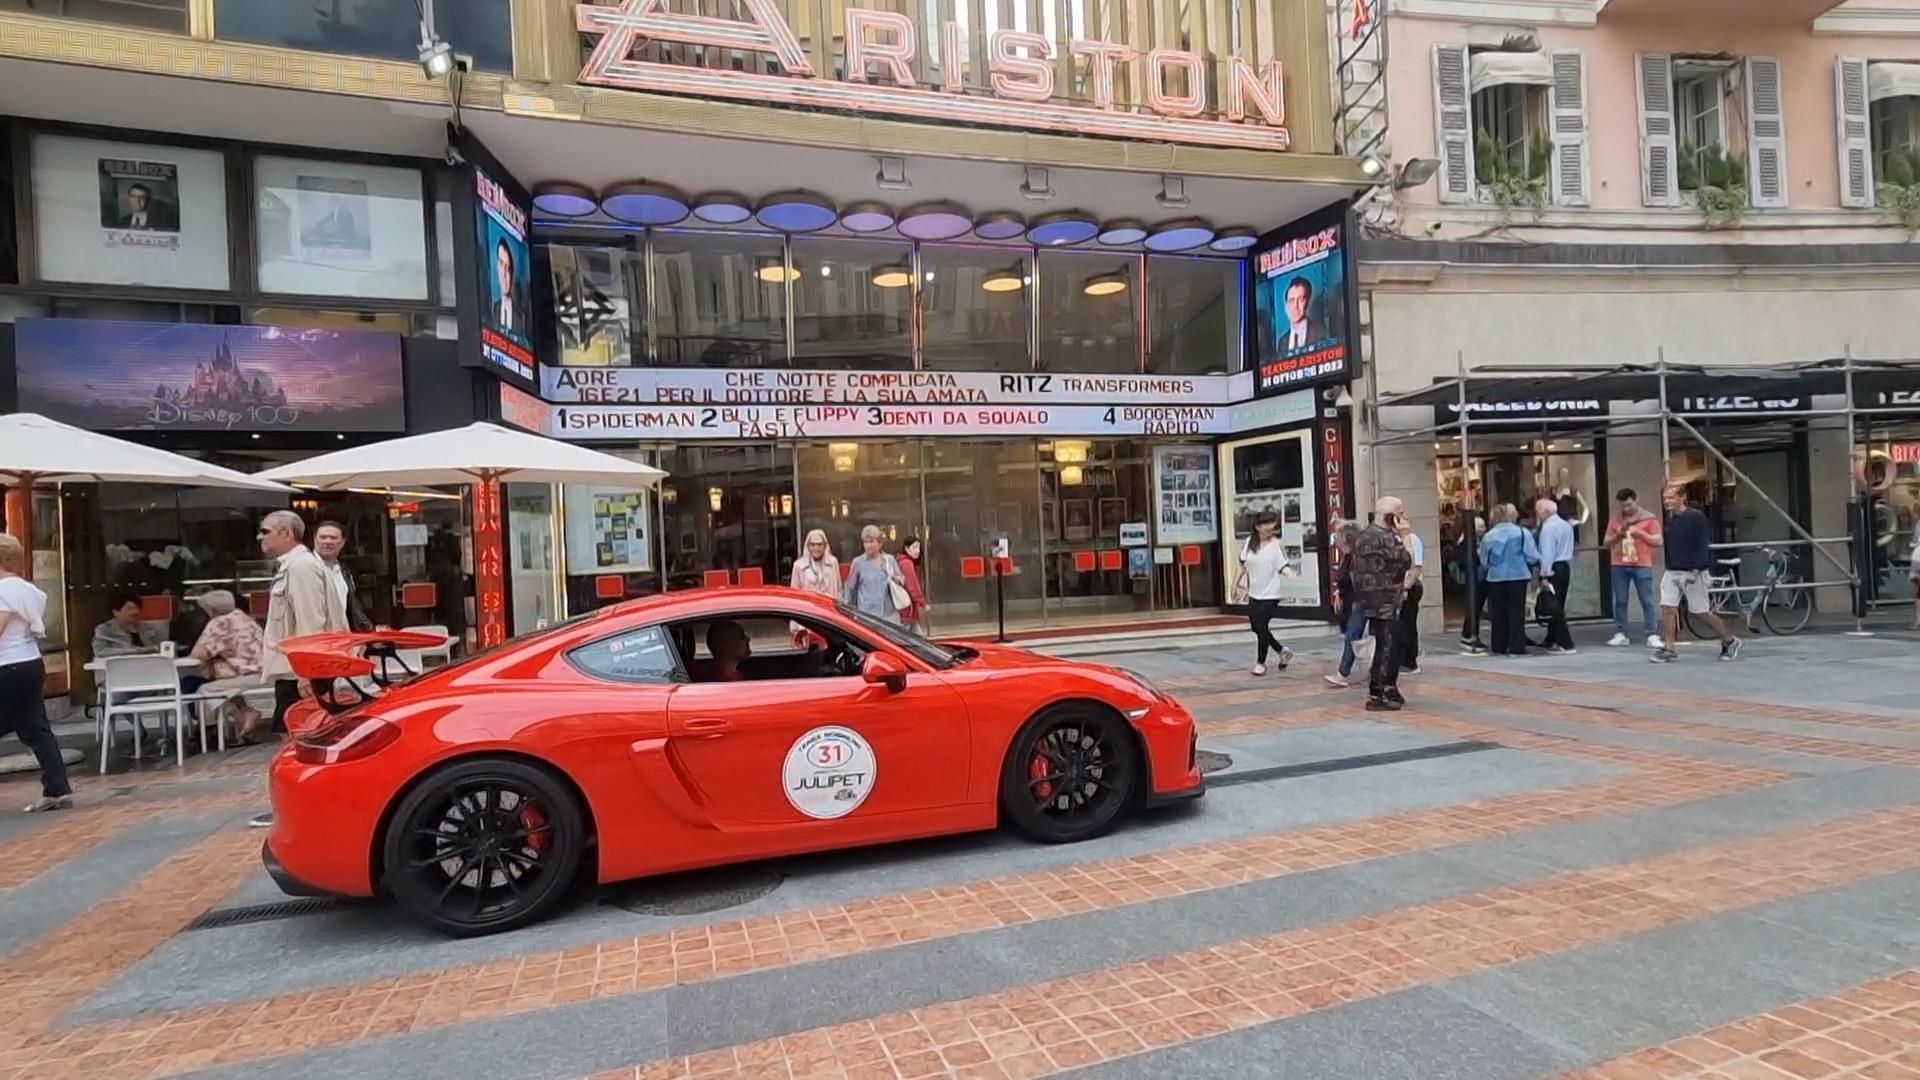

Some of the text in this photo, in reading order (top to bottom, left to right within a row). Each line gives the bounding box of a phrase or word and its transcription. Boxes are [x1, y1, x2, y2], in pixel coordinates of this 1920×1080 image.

[576, 0, 1287, 128] ARISTON
[725, 372, 957, 387] CHE NOTTE COMPLICATA
[1000, 375, 1194, 394] RITZ TRANSFORMERS
[656, 387, 694, 402] PER
[725, 388, 813, 402] DOTTORE
[843, 389, 866, 402] LA
[877, 389, 917, 402] SUA
[926, 389, 988, 402] AMATA
[148, 400, 298, 431] Disney 100
[701, 408, 859, 427] 2 BLU E FLIPPY
[943, 412, 968, 425] DA
[978, 411, 1049, 425] SQUALO
[1103, 407, 1116, 425] 4
[1123, 408, 1215, 421] BOOGEYMAN
[739, 421, 789, 437] FAST
[1144, 421, 1200, 434] RAPITO
[819, 745, 841, 763] 31
[793, 772, 865, 791] JULIPET
